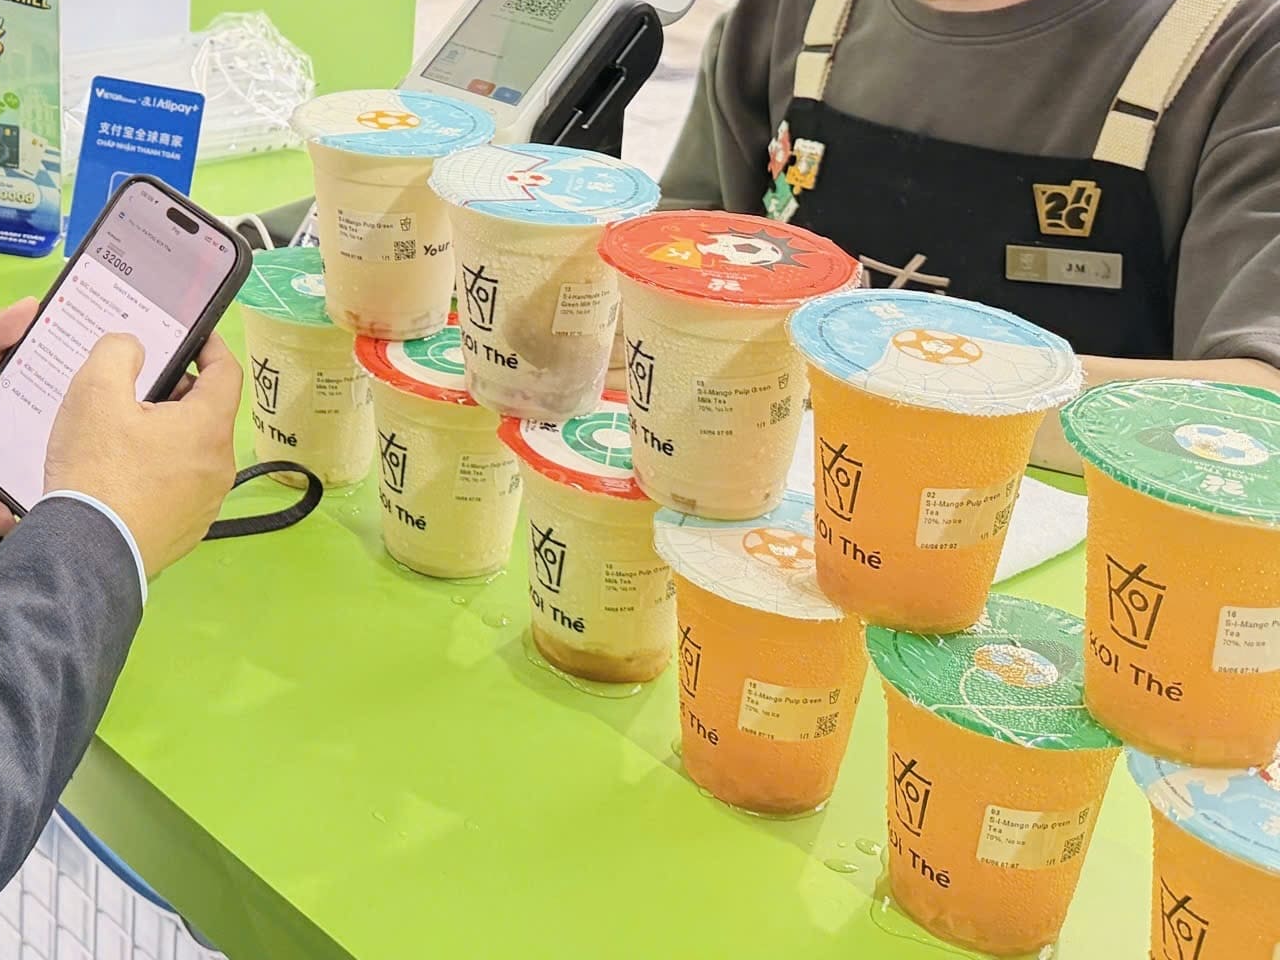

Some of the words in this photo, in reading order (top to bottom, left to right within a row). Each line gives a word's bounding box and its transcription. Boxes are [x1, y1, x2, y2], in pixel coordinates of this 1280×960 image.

[136, 146, 160, 157] THANH
[160, 149, 181, 160] TOÁN
[423, 241, 450, 257] Your
[101, 249, 134, 277] 32000
[483, 344, 518, 369] Thé
[269, 424, 297, 447] Thé
[641, 425, 674, 457] Thé
[396, 504, 427, 530] Thé
[839, 536, 882, 570] Thé
[550, 606, 585, 634] Thé
[1225, 629, 1240, 637] Tea
[1129, 663, 1184, 702] Thé
[688, 711, 719, 746] Thé
[988, 825, 1002, 834] Tea
[909, 848, 950, 889] Thé
